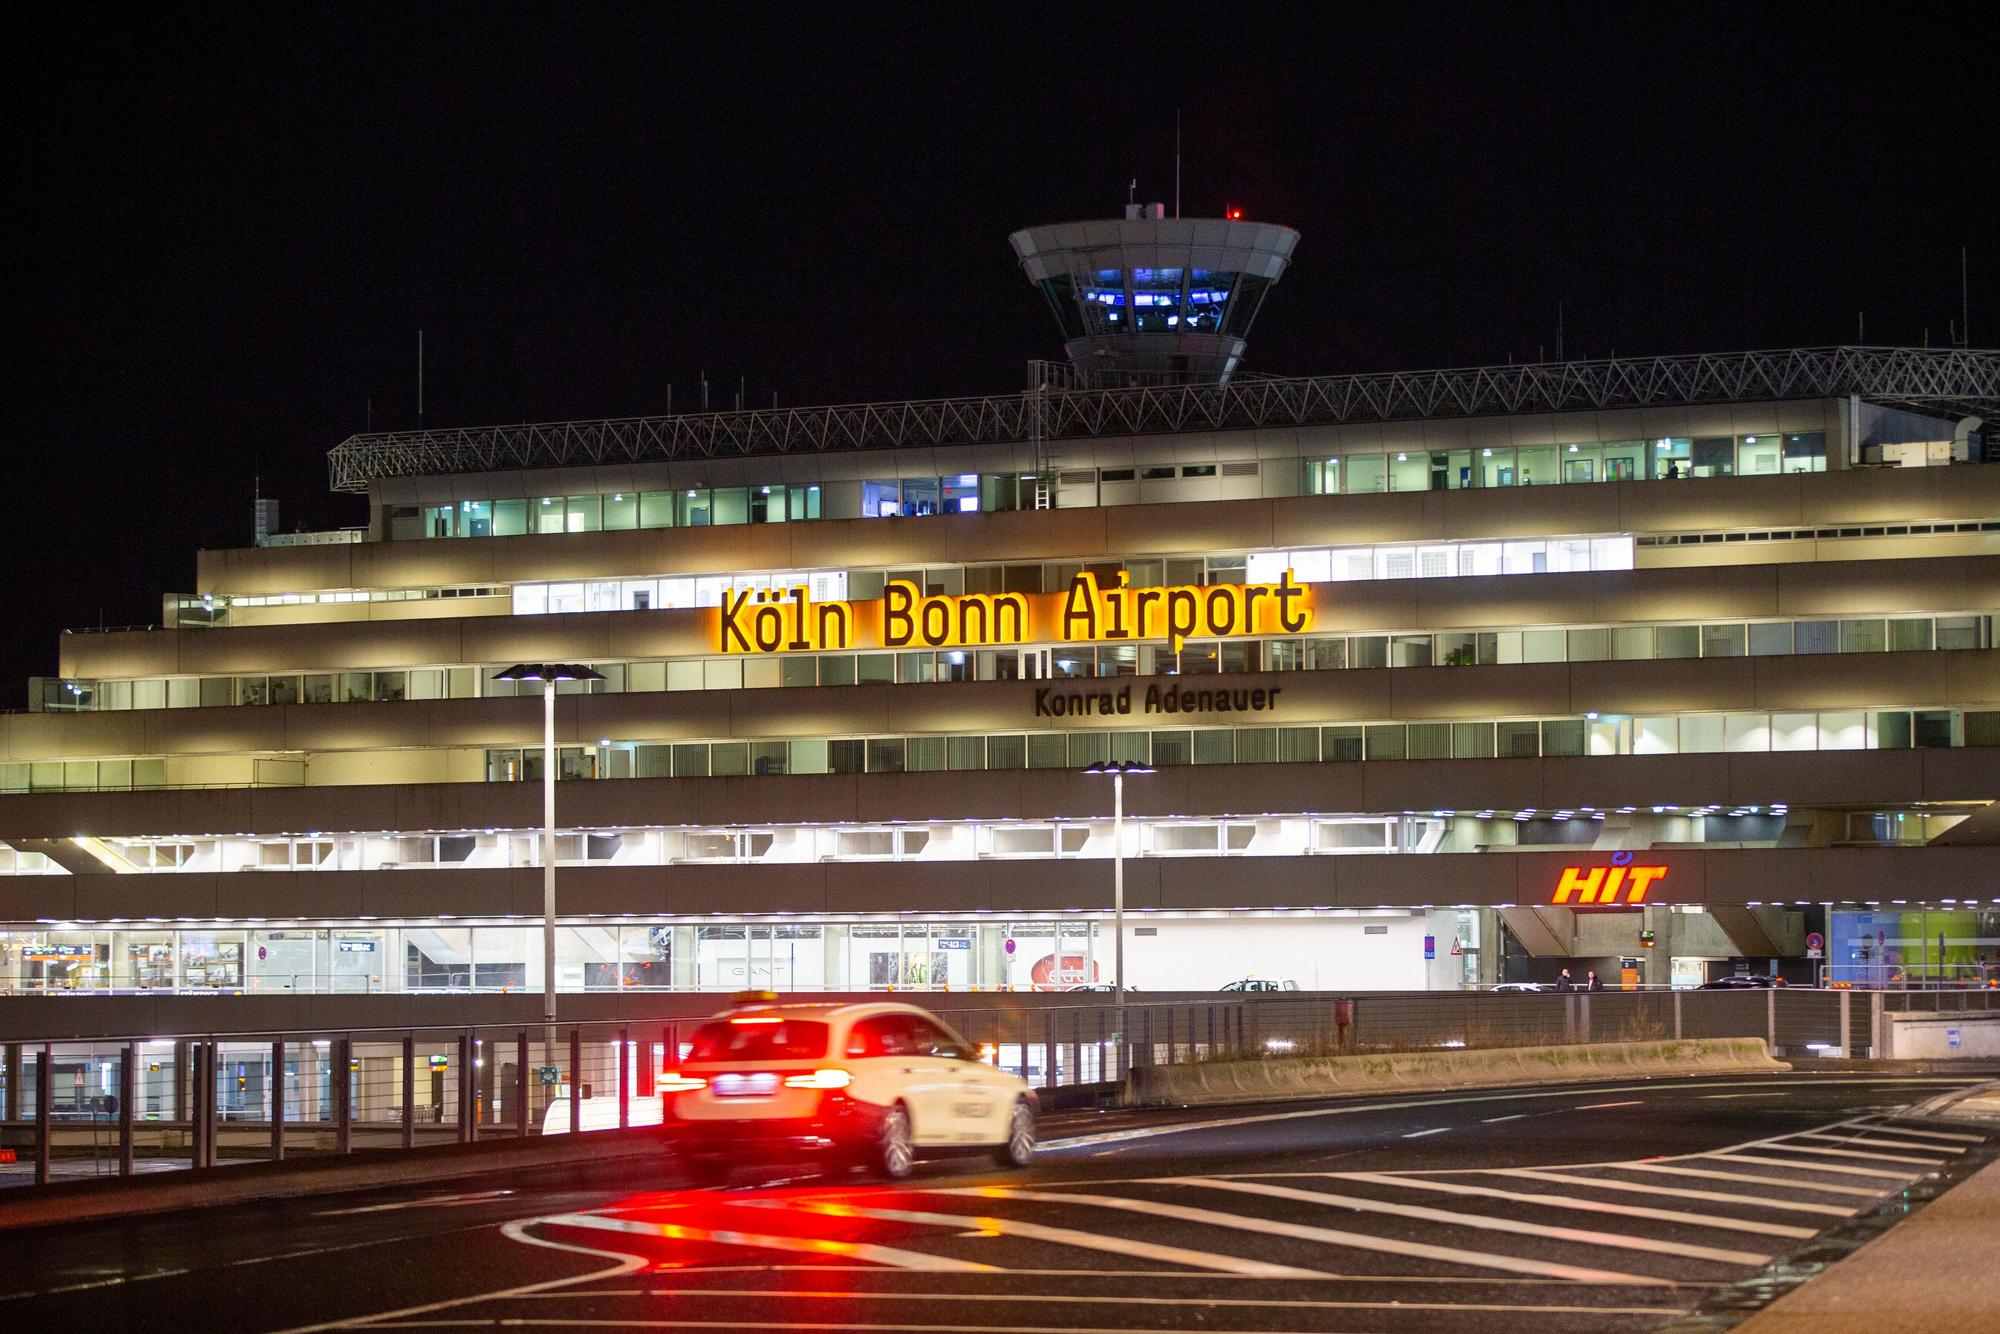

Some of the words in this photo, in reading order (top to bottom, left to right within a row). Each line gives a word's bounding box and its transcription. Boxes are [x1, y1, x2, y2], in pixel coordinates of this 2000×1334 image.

[721, 585, 853, 653] Köln
[883, 579, 1028, 649] Bonn
[1063, 567, 1311, 655] Airport
[1035, 686, 1131, 718] Konrad
[1145, 684, 1282, 714] Adenauer
[1551, 851, 1668, 904] HIT
[732, 967, 784, 976] GANT
